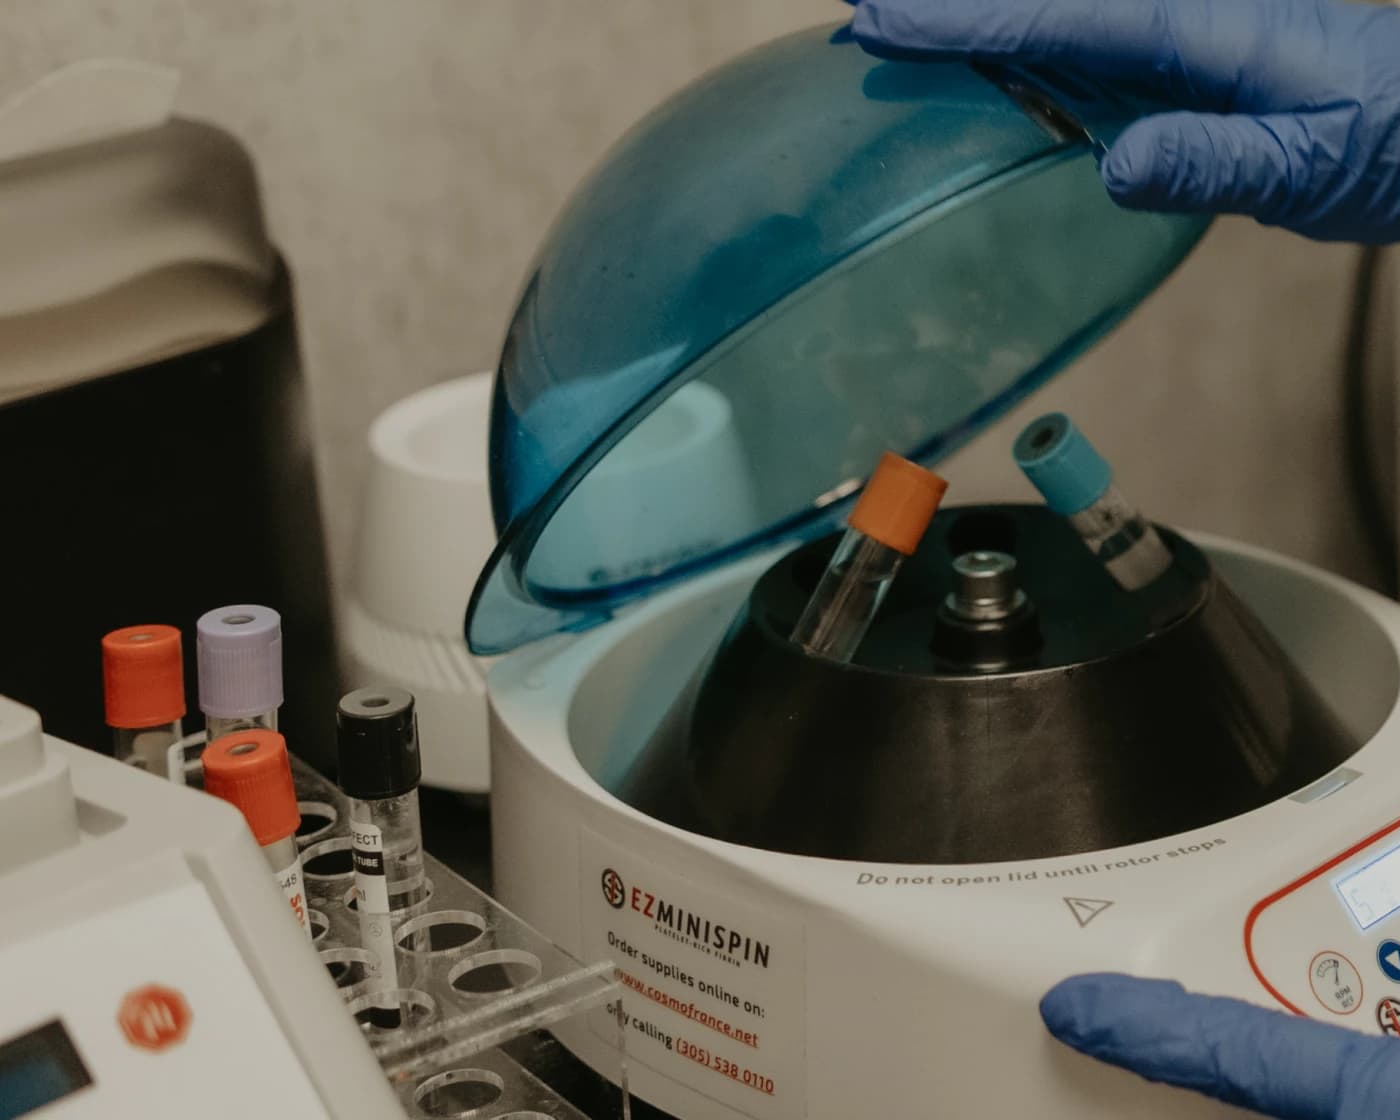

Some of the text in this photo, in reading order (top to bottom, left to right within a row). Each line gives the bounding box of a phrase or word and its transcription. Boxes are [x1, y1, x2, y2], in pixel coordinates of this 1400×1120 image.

[357, 856, 379, 868] TUBE
[856, 837, 1227, 886] Do not open lid until rotor stops
[631, 886, 770, 969] EZMINISPIN
[607, 931, 765, 1018] Order supplies online on:
[632, 1017, 673, 1050] calling
[676, 1036, 710, 1068] (305)
[714, 1055, 738, 1078] 538
[743, 1069, 775, 1094] 0110
